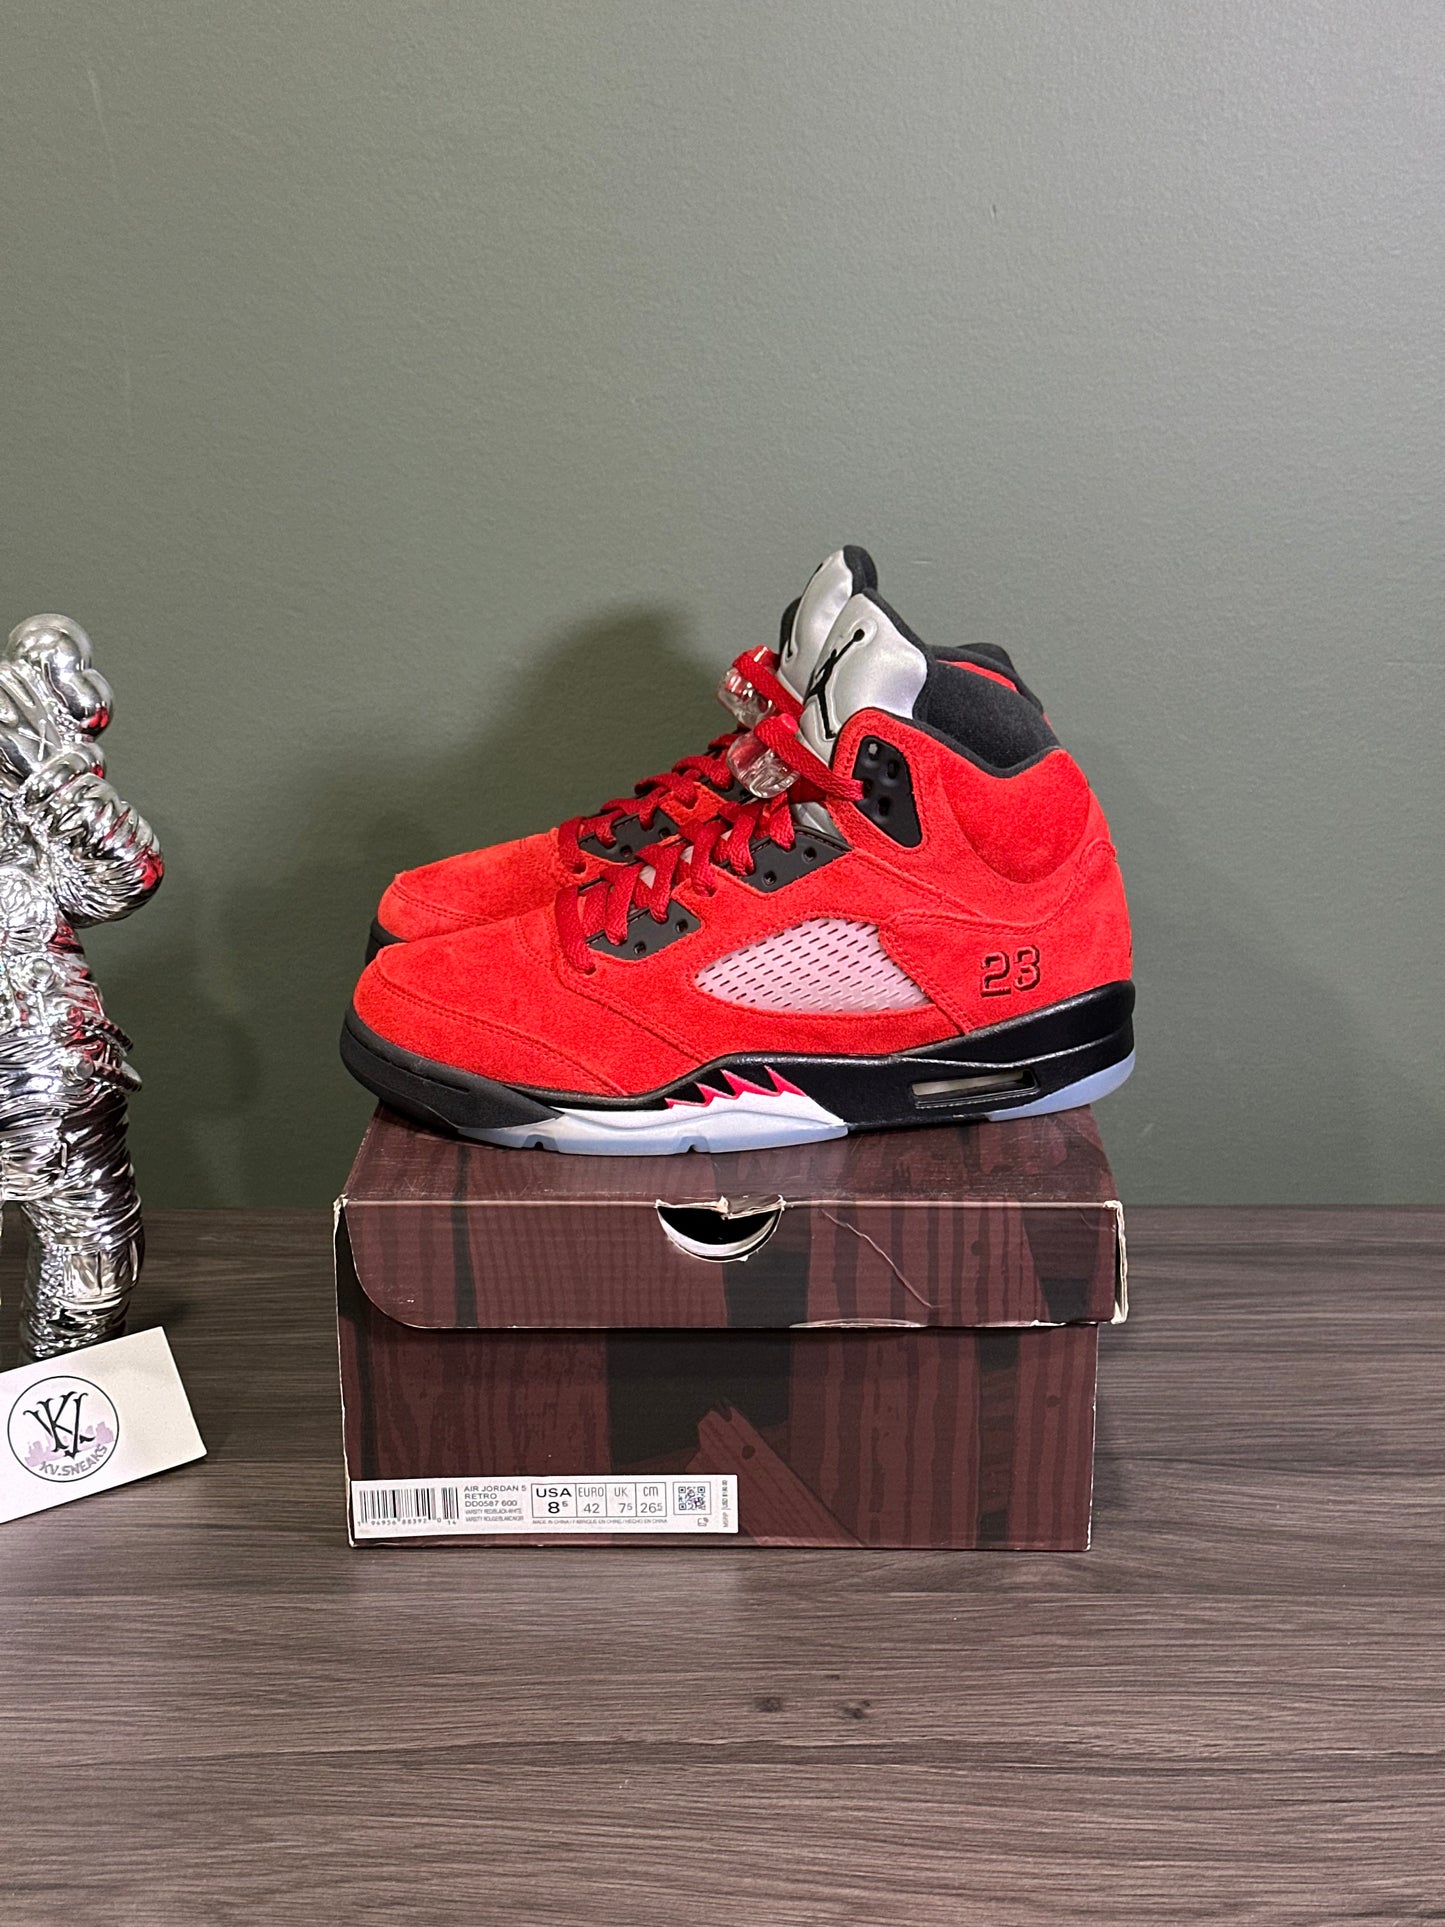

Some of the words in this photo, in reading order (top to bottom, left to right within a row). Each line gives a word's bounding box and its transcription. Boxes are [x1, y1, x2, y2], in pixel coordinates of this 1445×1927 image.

[978, 944, 1040, 998] 23
[39, 1444, 108, 1476] KV.SNEAKS
[536, 1487, 572, 1498] USA
[578, 1487, 604, 1497] EURO
[614, 1487, 628, 1497] UK
[583, 1503, 600, 1514] 42
